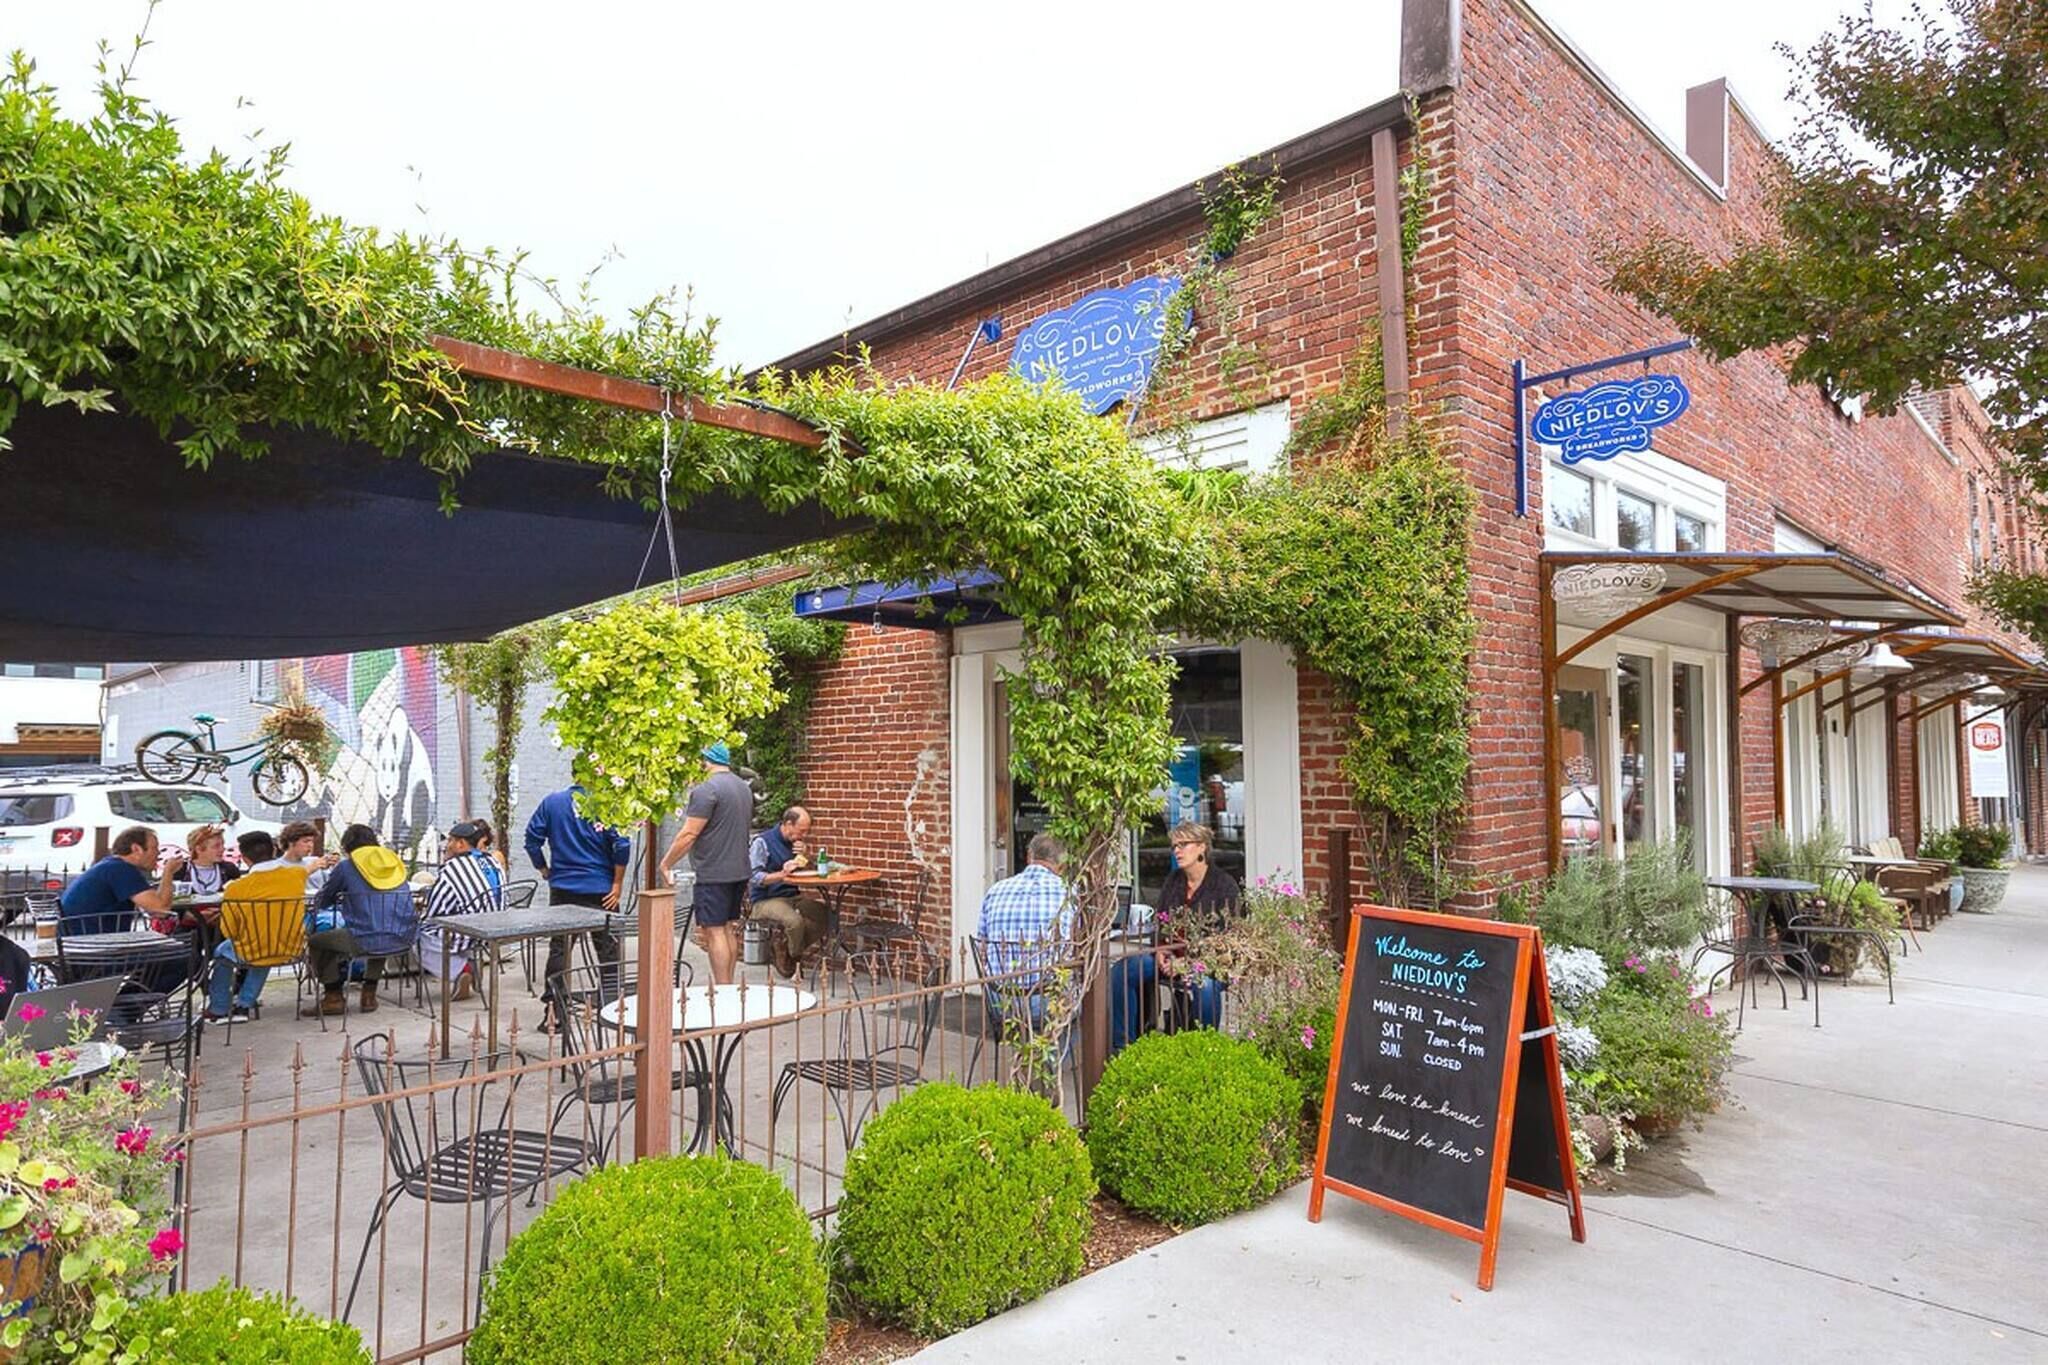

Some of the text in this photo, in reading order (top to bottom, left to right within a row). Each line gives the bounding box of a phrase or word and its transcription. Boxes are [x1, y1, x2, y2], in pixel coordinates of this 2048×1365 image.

[1073, 373, 1134, 396] ADWORKS
[1550, 399, 1670, 435] NIEDLOV'S
[1563, 576, 1652, 594] NIEDLOV'S
[1375, 936, 1486, 969] Welcome to
[1392, 963, 1467, 993] NIEDLOV'S
[1381, 1021, 1404, 1040] SAT.
[1380, 1040, 1462, 1071] SUN. CLOSED
[1351, 1081, 1485, 1128] we love to knead
[1345, 1113, 1363, 1128] we
[1414, 1132, 1436, 1149] to
[1438, 1141, 1472, 1163] love
